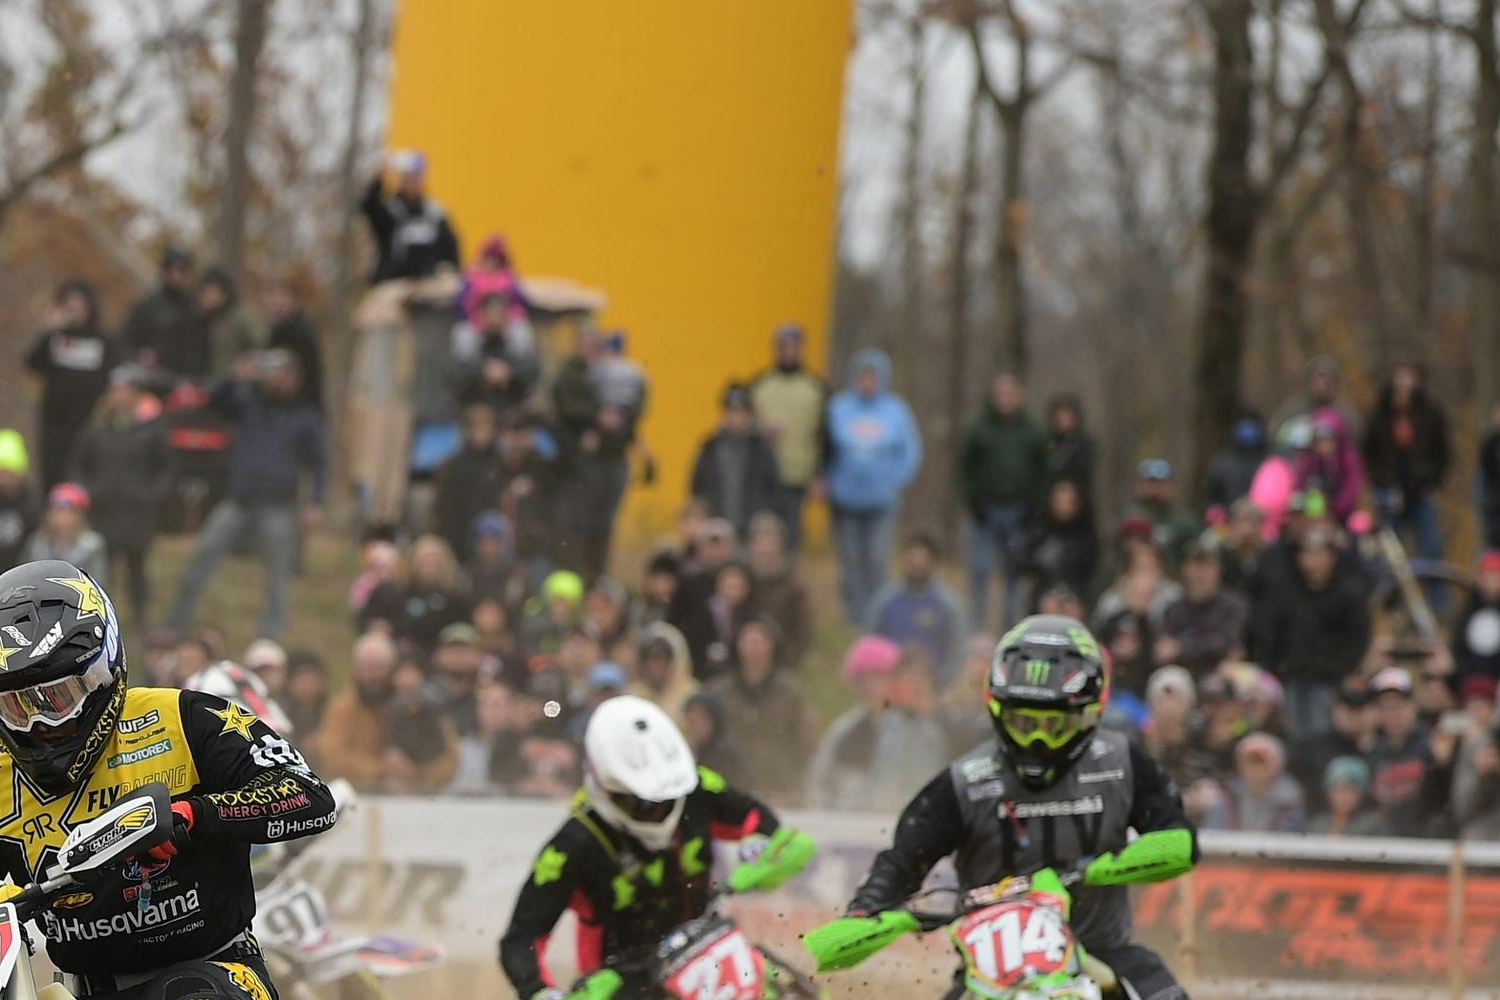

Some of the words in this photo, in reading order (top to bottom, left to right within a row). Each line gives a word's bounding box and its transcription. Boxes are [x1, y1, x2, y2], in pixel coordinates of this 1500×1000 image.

[117, 709, 159, 734] WPS
[122, 740, 170, 763] MOTOREX
[90, 823, 128, 852] CYCRA
[63, 888, 201, 943] Husqvarna
[964, 905, 1067, 982] 114
